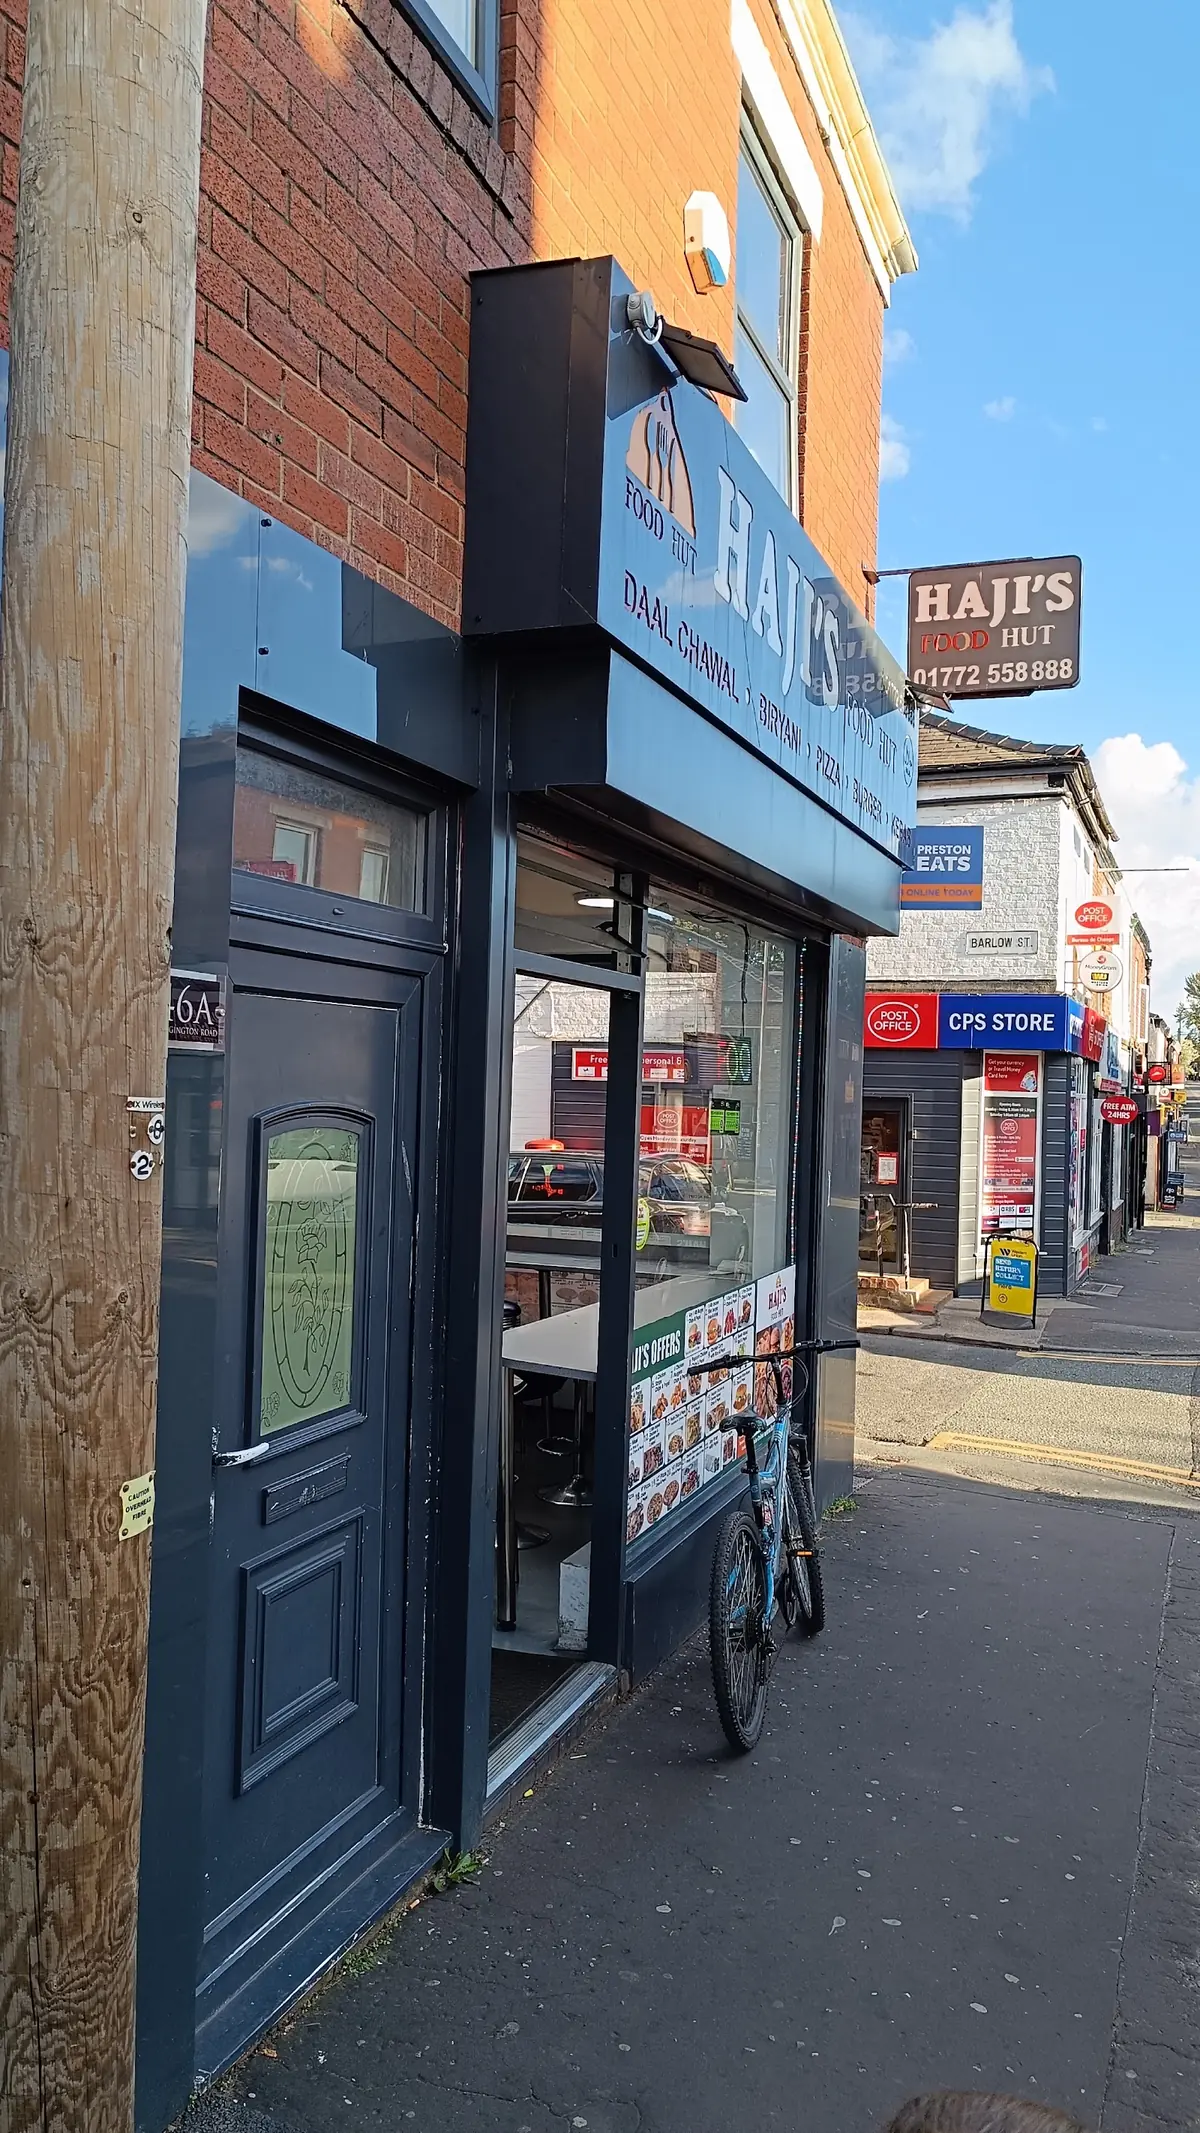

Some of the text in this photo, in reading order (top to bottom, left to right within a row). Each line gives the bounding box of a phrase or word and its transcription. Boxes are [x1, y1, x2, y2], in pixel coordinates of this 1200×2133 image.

[625, 476, 698, 575] FOOD HUT
[713, 465, 840, 712] HAJI'S
[915, 572, 1074, 628] HAJI'S
[921, 625, 1056, 654] FOOD HUT
[913, 664, 980, 687] 01772
[624, 568, 673, 648] DAAL
[677, 620, 740, 704] CHAWAL
[758, 692, 802, 757] BIRYANI
[815, 745, 842, 790] PIZZA
[851, 777, 883, 825] BURGER
[891, 812, 913, 848] KEBAB
[846, 690, 898, 775] FOOD HUT
[917, 844, 972, 855] PRESTON
[916, 856, 971, 872] EATS
[906, 888, 939, 897] ONLINE
[943, 888, 974, 897] TODAY
[1083, 906, 1106, 915] POST
[1078, 914, 1108, 923] OFFICE
[971, 937, 1033, 948] BARLOW ST.
[880, 1010, 909, 1021] POST
[949, 1012, 987, 1031] CPS
[992, 1013, 1055, 1032] STORE
[200, 1028, 218, 1037] ROAD
[873, 1020, 913, 1031] OFFICE
[590, 1054, 608, 1064] Free
[1103, 1102, 1136, 1111] FREE ATM
[1107, 1111, 1130, 1119] 24HRS
[137, 1154, 149, 1175] 2
[995, 1272, 1025, 1281] COLLECT
[769, 1286, 787, 1310] HAJI'S
[651, 1329, 681, 1365] OFFERS
[128, 1487, 149, 1501] CAUTION
[126, 1496, 151, 1512] OVERHEAD
[132, 1509, 146, 1520] FIBRE
